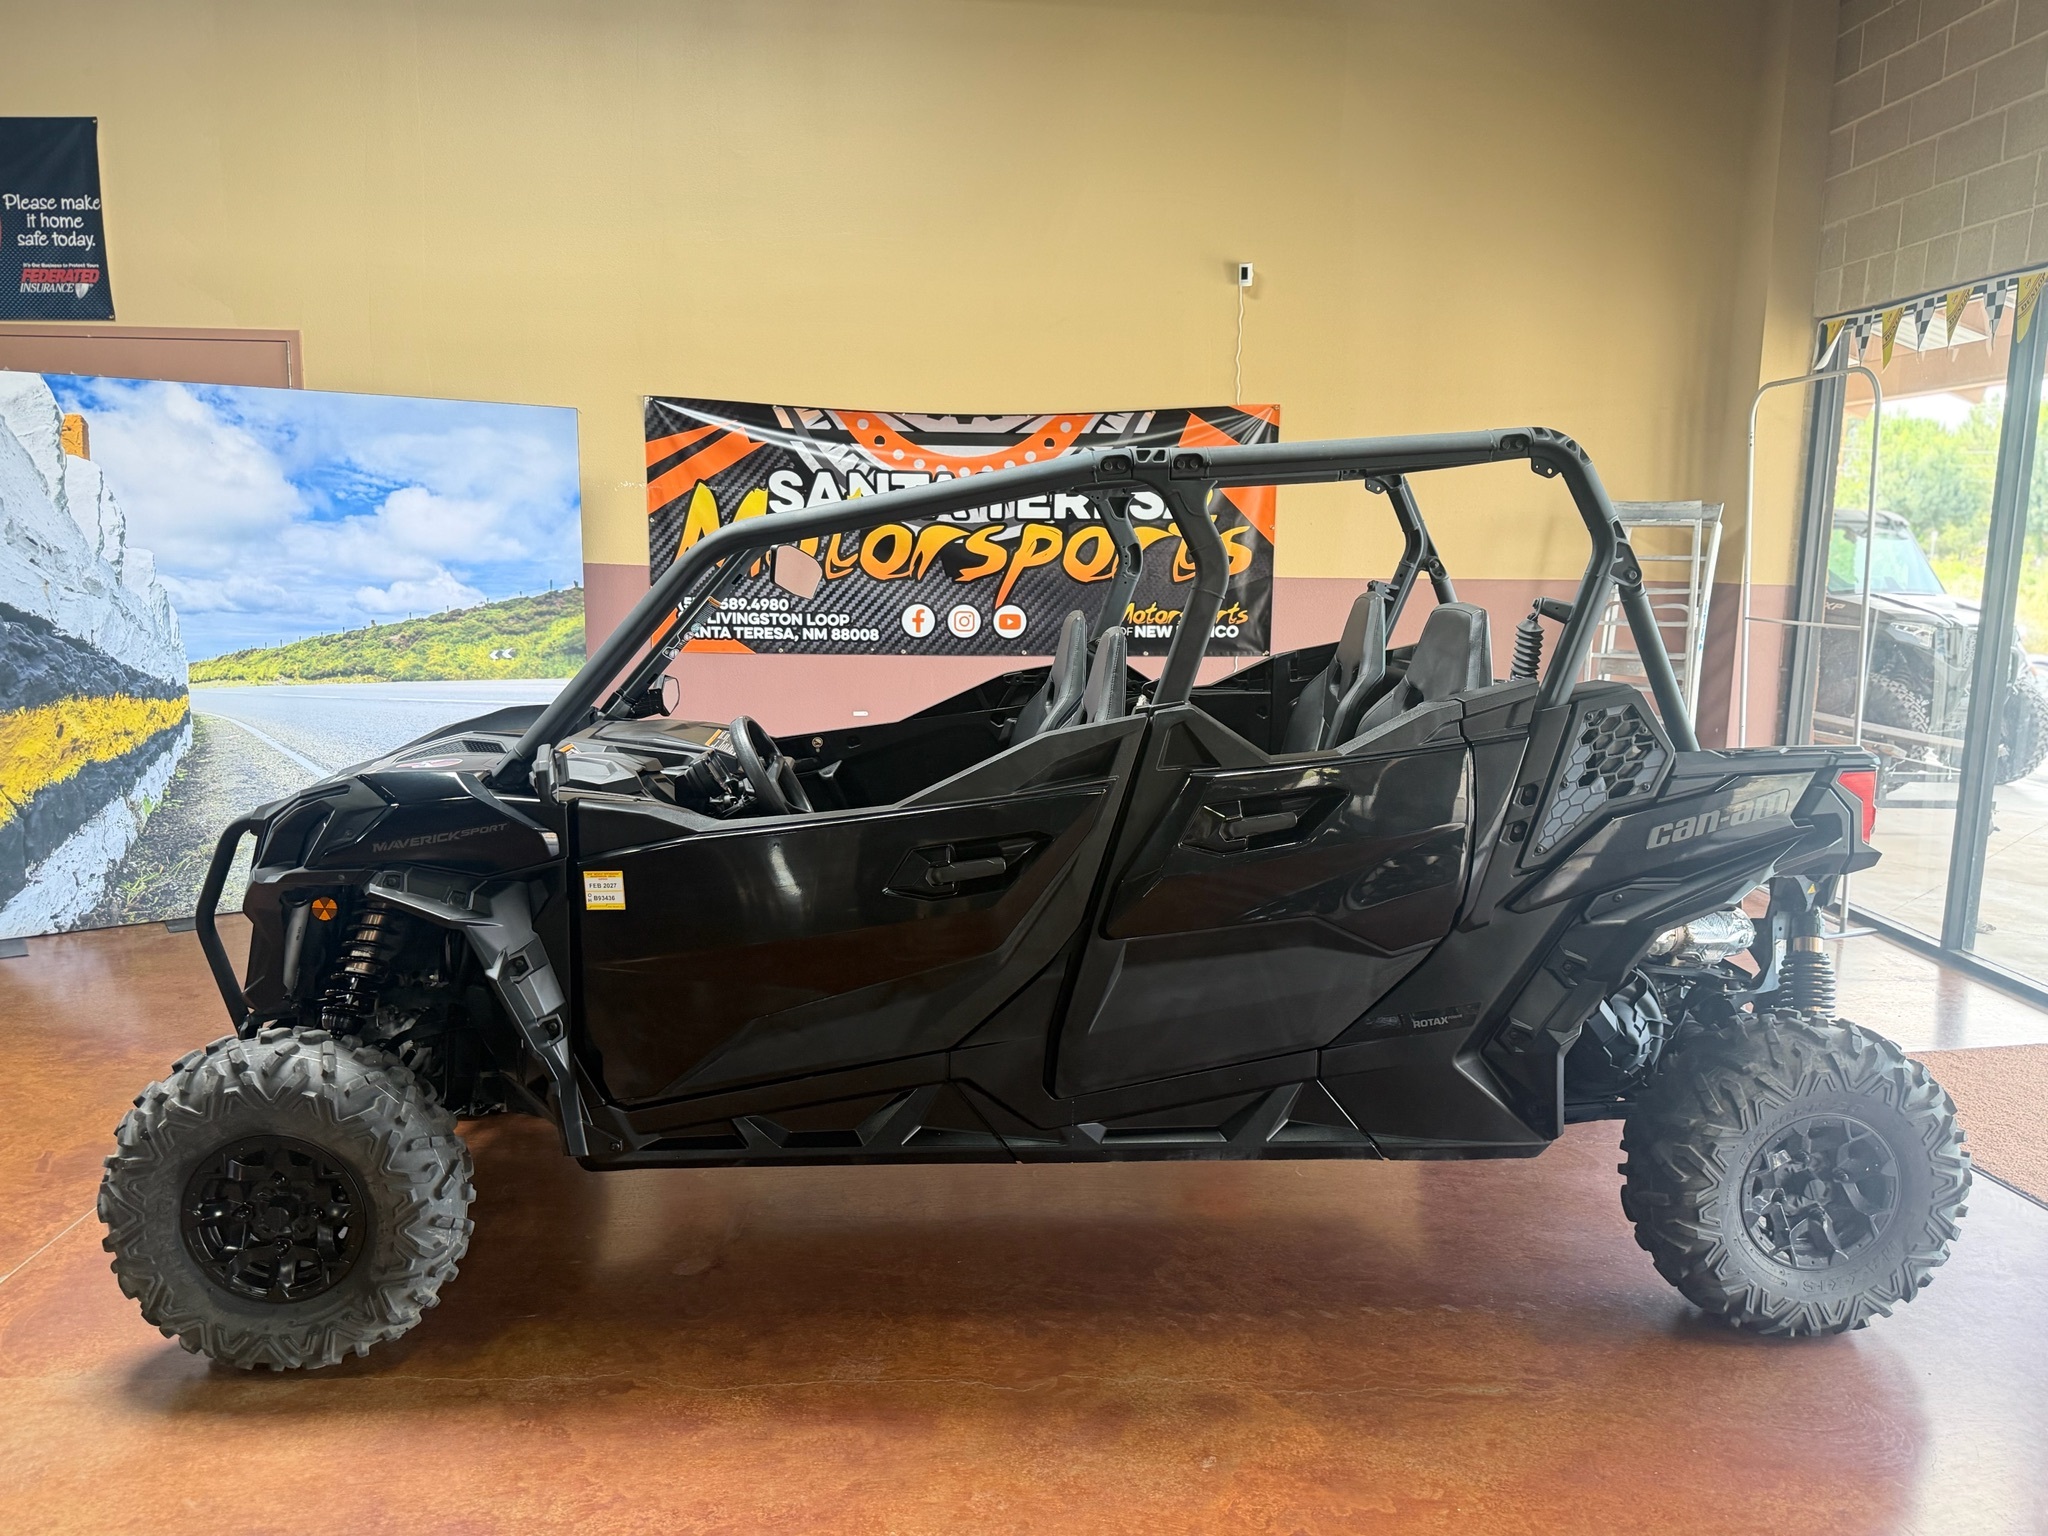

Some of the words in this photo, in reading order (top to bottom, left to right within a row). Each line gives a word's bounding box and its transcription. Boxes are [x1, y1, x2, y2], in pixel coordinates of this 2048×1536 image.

[2, 193, 57, 210] Please
[61, 194, 101, 210] make
[26, 213, 36, 228] it
[40, 212, 84, 228] home
[17, 230, 49, 246] safe
[51, 231, 96, 251] today.
[21, 268, 99, 283] FEDERATED
[20, 283, 74, 292] INSURANCE
[707, 612, 803, 626] LIVINGSTON
[806, 613, 850, 627] LOOP
[1122, 602, 1249, 624] Motorrts
[693, 626, 731, 639] NTA
[733, 626, 799, 642] TERESA,
[803, 627, 828, 640] NM
[831, 628, 880, 641] 88008
[1134, 625, 1173, 638] NEW
[1646, 791, 1789, 850] can-am
[1413, 1016, 1449, 1029] ROTAX
